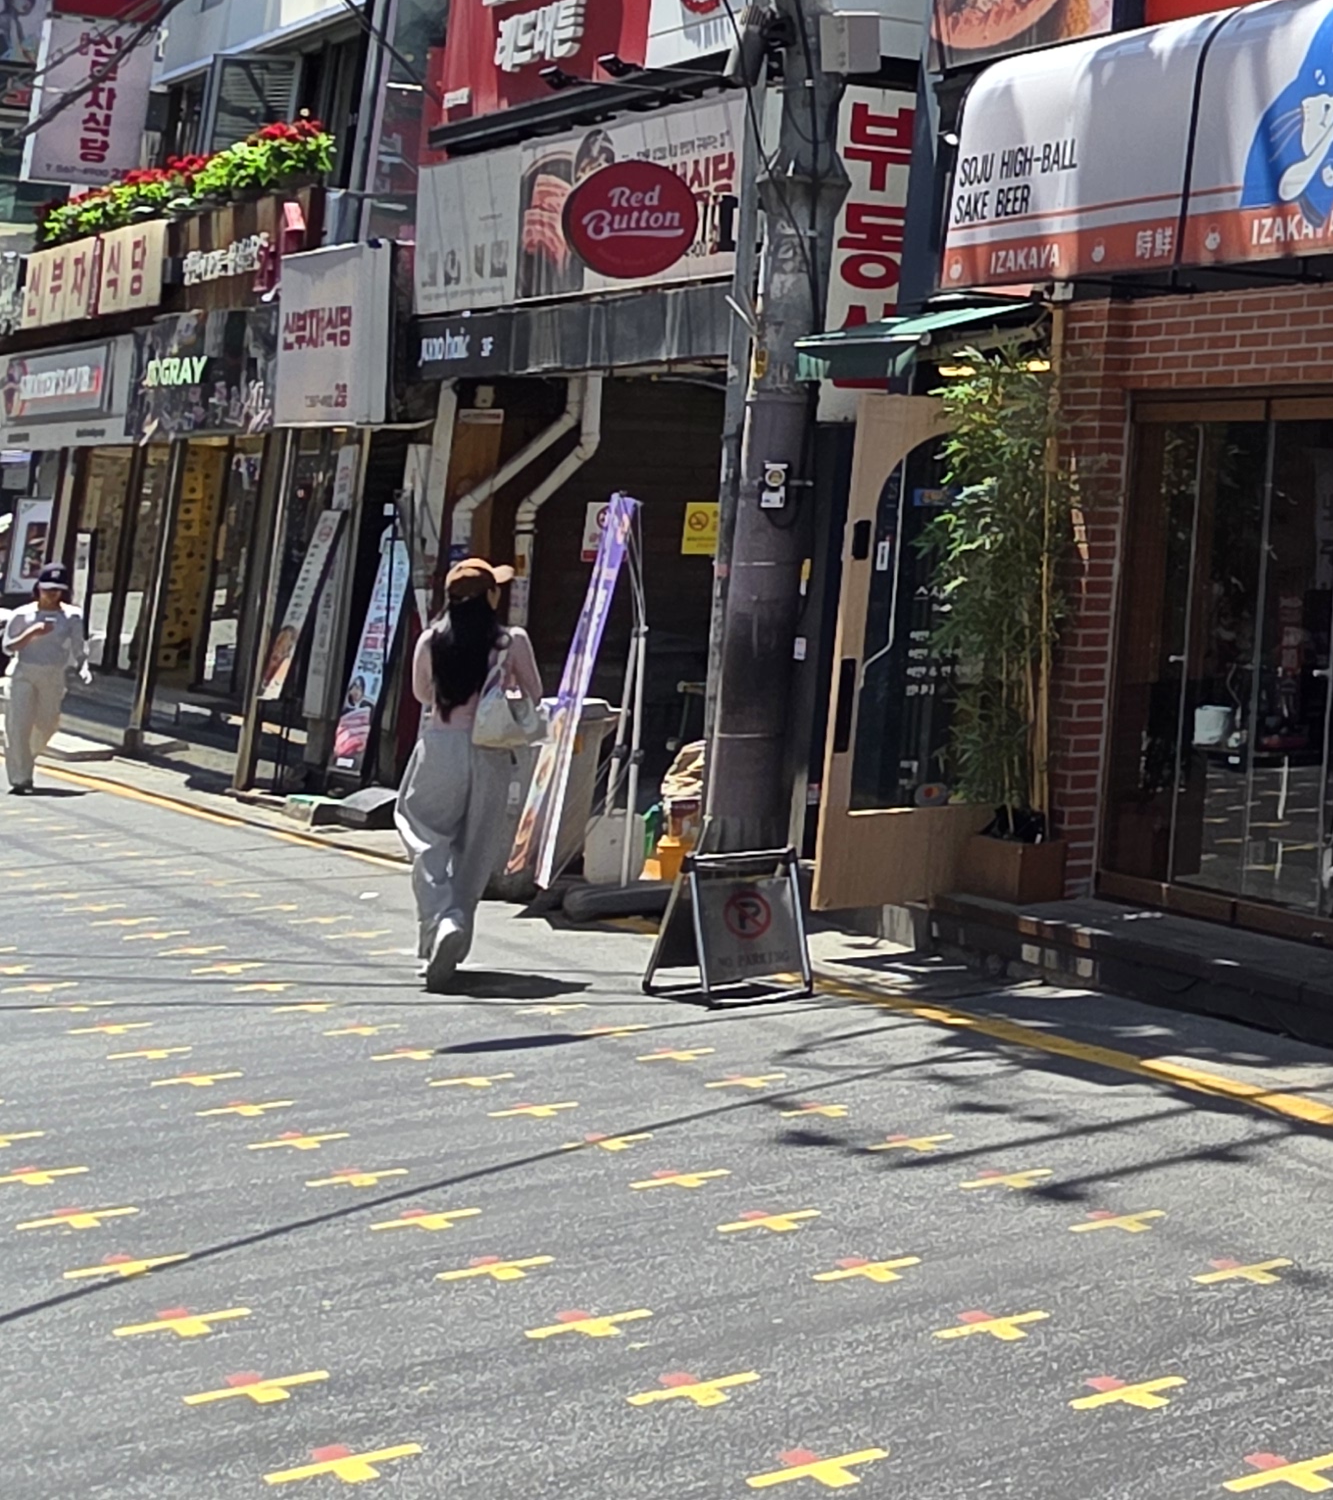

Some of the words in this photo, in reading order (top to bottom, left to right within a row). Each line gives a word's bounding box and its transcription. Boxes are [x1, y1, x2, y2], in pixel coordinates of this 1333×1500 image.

[959, 156, 995, 188] SOJU
[1000, 139, 1078, 180] HIGH-BALL
[607, 184, 660, 208] Red
[954, 190, 988, 225] SAKE
[995, 185, 1030, 219] BEER
[582, 209, 682, 240] Button
[990, 243, 1061, 275] IZAKAYA
[1135, 227, 1173, 259] 時鮮
